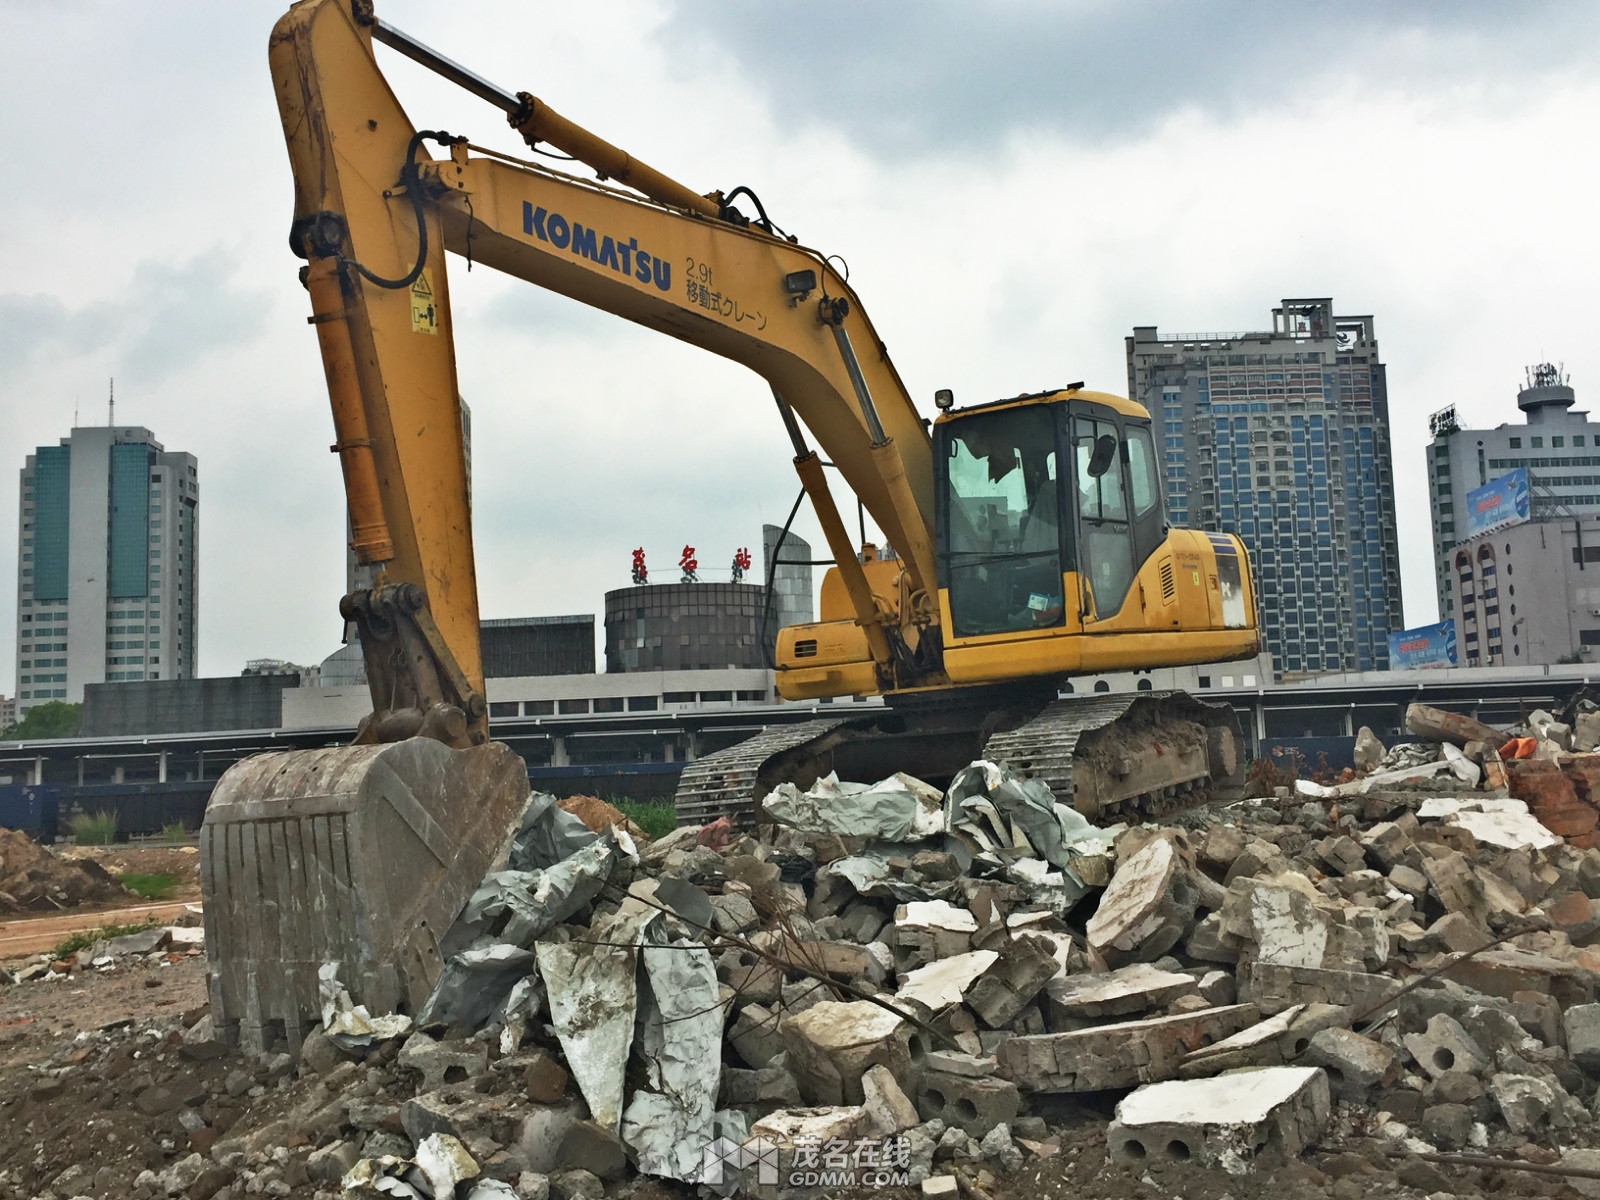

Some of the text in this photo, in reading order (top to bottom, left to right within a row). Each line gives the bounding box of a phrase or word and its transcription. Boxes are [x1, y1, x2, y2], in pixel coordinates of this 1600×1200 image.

[522, 200, 671, 291] KOMATSU
[685, 256, 713, 286] 2.9t
[686, 278, 768, 331] 移動式クレーン
[632, 545, 752, 577] 茂名站
